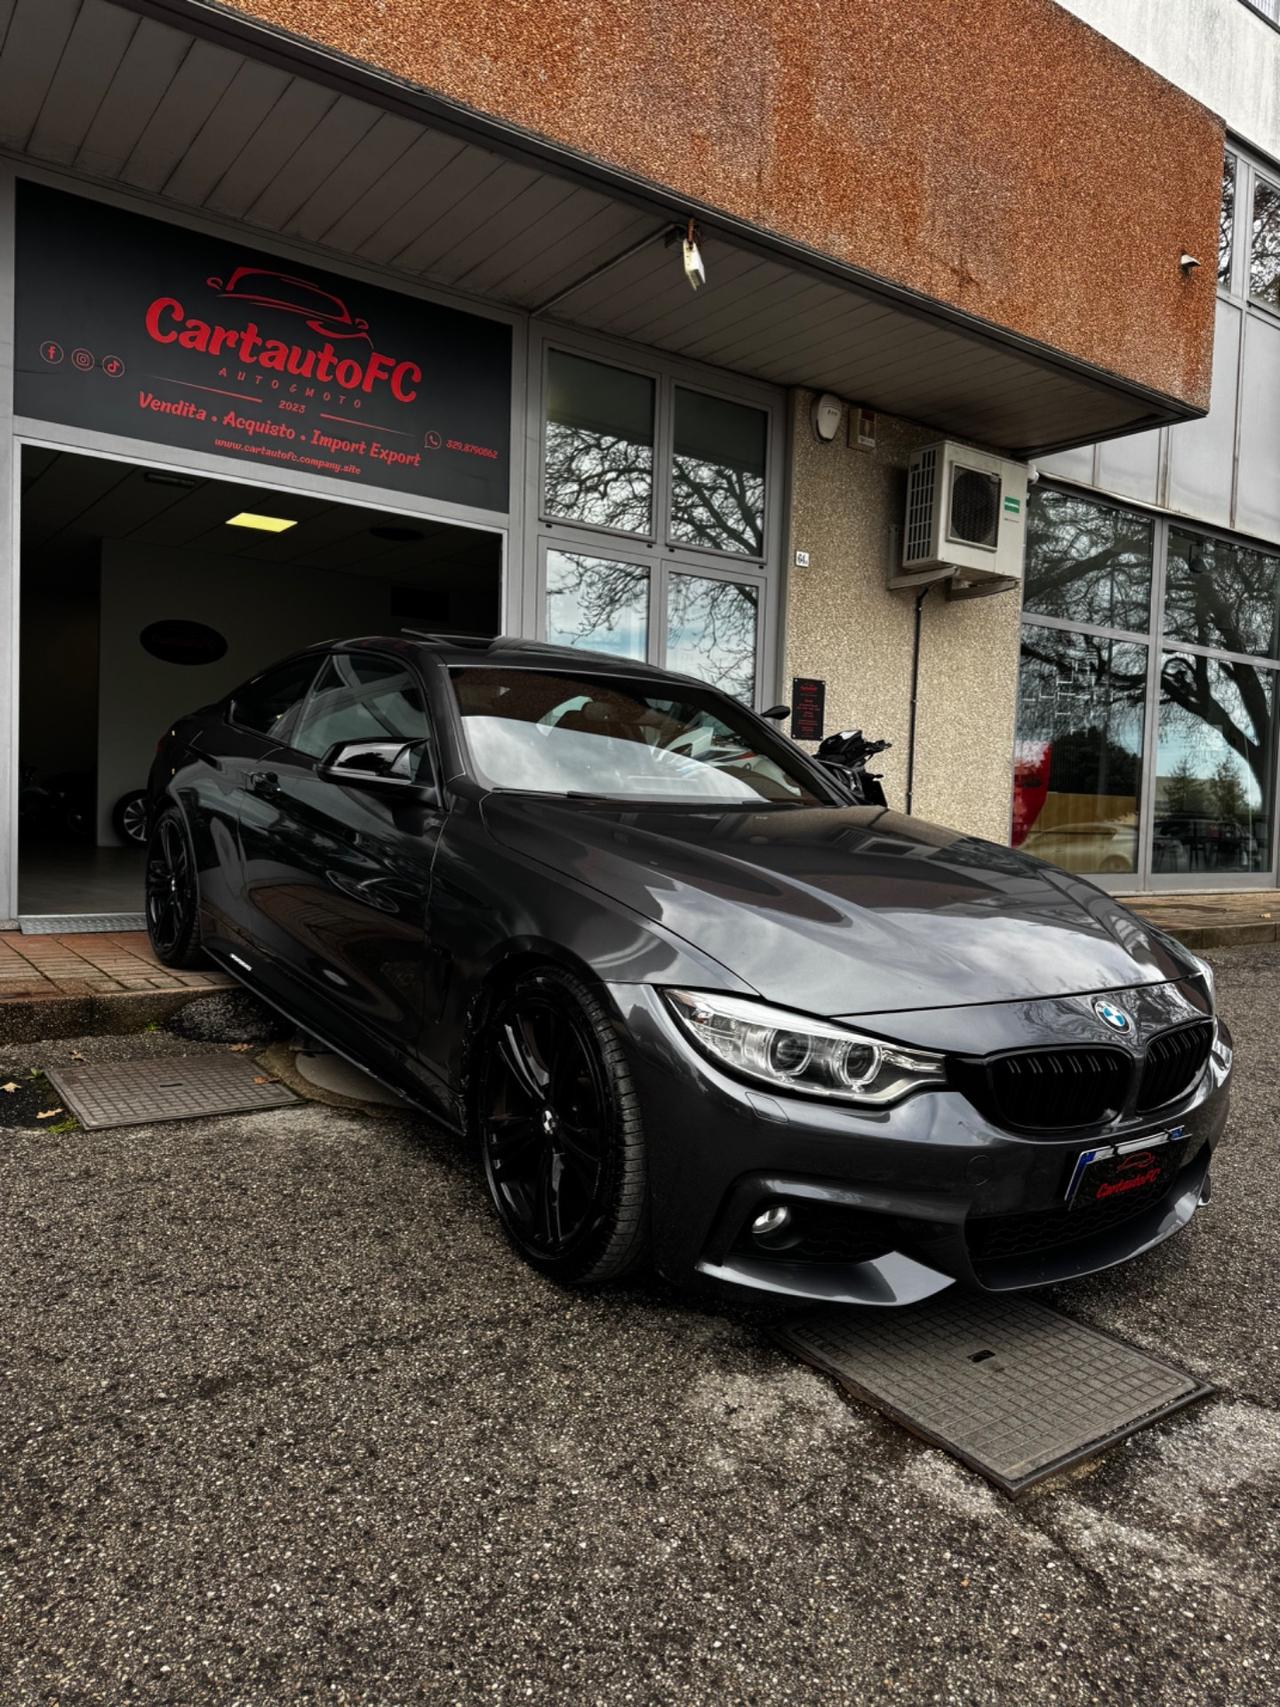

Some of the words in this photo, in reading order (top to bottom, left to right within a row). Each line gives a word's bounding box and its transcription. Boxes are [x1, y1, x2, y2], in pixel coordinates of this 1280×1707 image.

[144, 296, 422, 405] CartautoFC
[137, 391, 207, 422] Vendita
[223, 410, 296, 440] Acquisto
[310, 429, 368, 456] Import
[369, 441, 422, 468] Export
[278, 399, 305, 415] 2023
[214, 438, 361, 475] www.cartautofc.company.site
